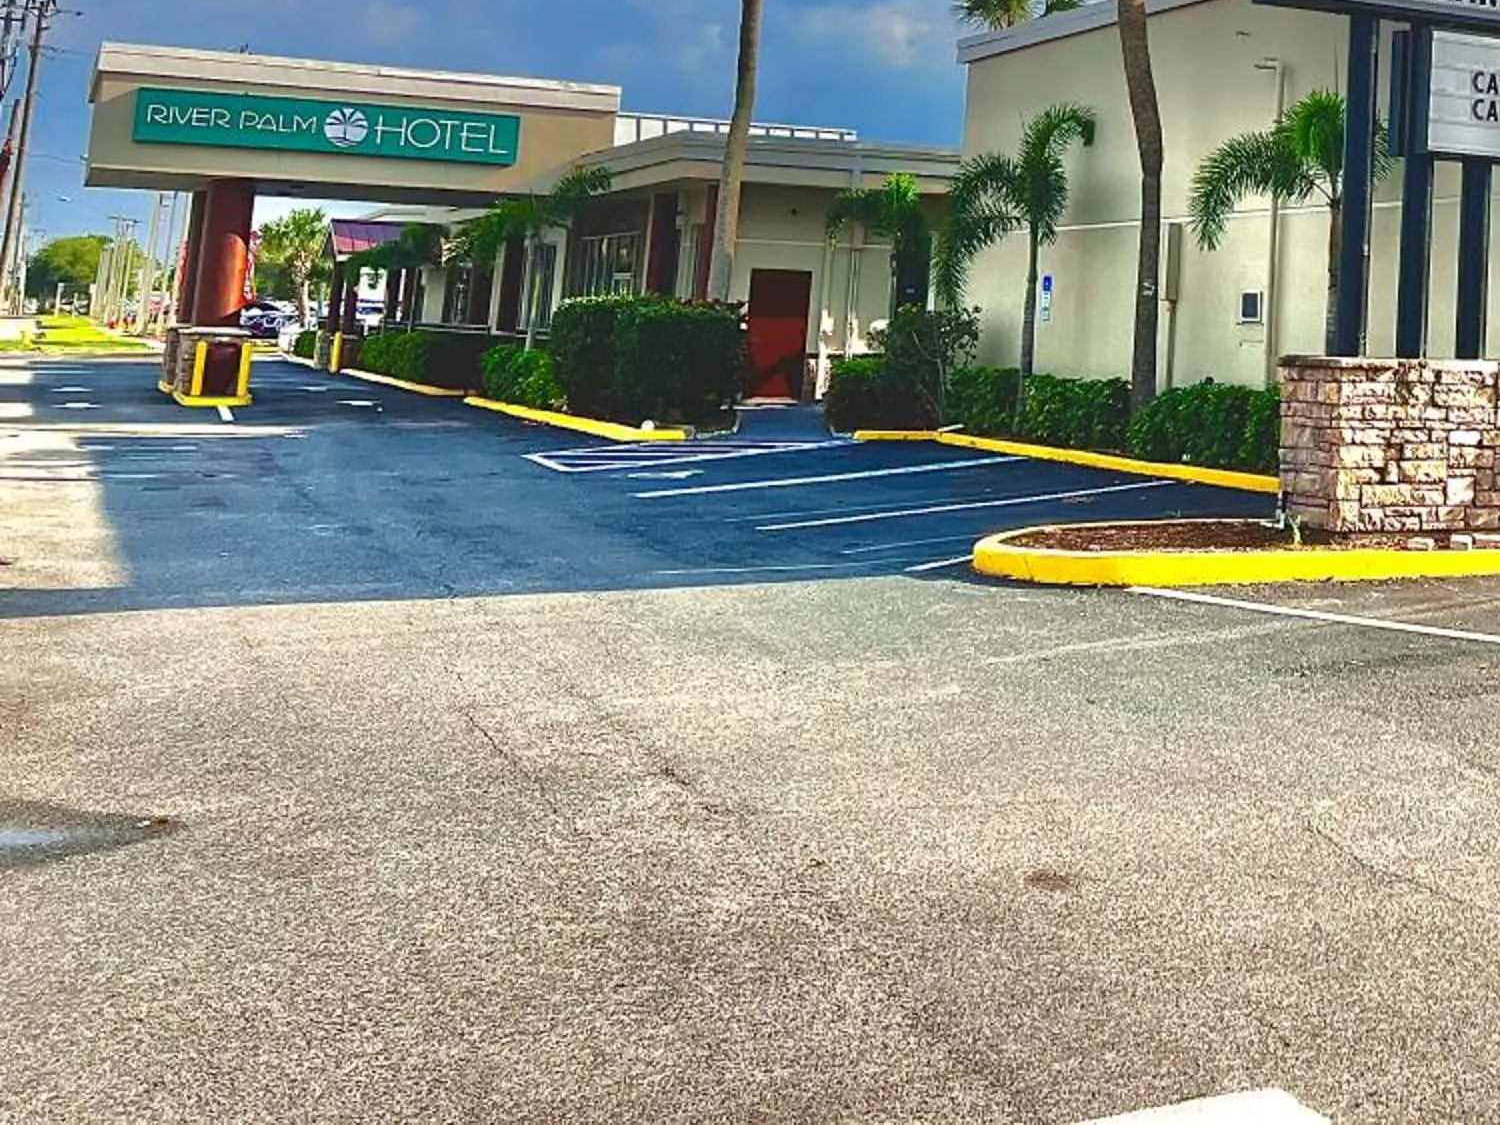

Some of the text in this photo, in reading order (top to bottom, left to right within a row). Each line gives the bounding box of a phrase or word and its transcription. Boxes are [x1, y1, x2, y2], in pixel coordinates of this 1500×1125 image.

[147, 104, 509, 154] RIVER PALM HOTEL
